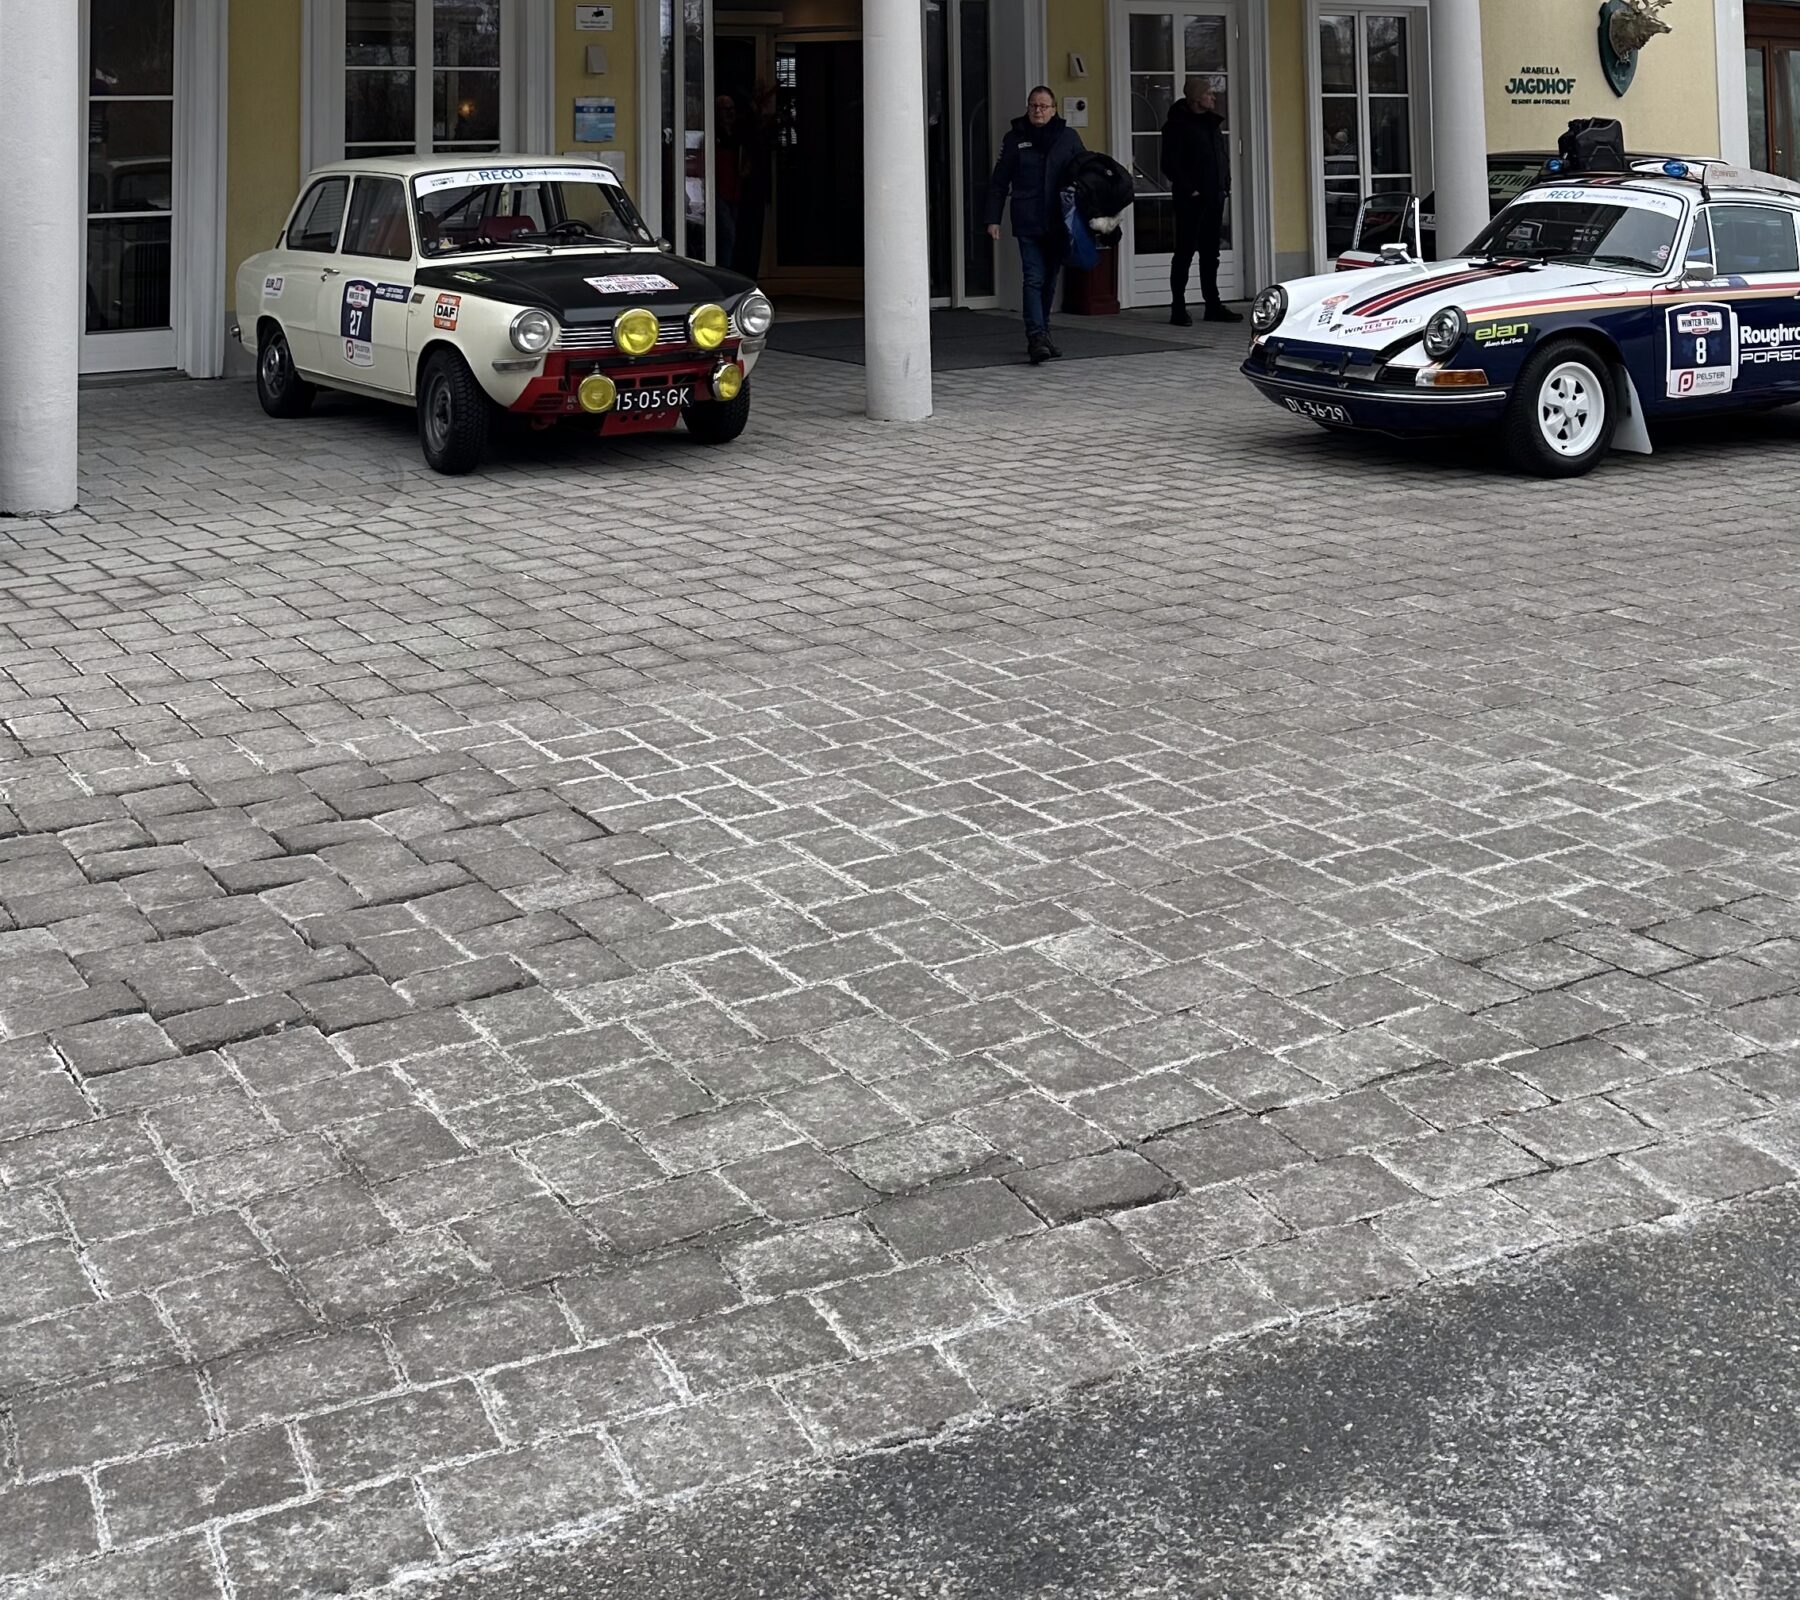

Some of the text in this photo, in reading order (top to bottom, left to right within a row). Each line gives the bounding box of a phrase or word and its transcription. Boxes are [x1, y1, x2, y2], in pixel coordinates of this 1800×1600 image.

[1505, 78, 1576, 94] JAGDHOF
[478, 168, 523, 181] RECO
[1546, 190, 1584, 200] RECO
[436, 304, 456, 318] DAF
[349, 309, 363, 337] 27
[1344, 318, 1416, 334] WINTER TRIAL
[1681, 317, 1718, 327] WINTER TRIAL
[1475, 323, 1529, 340] elan
[1695, 337, 1707, 364] 8
[1696, 371, 1726, 380] PELSTER
[615, 387, 690, 411] 15-05-GK
